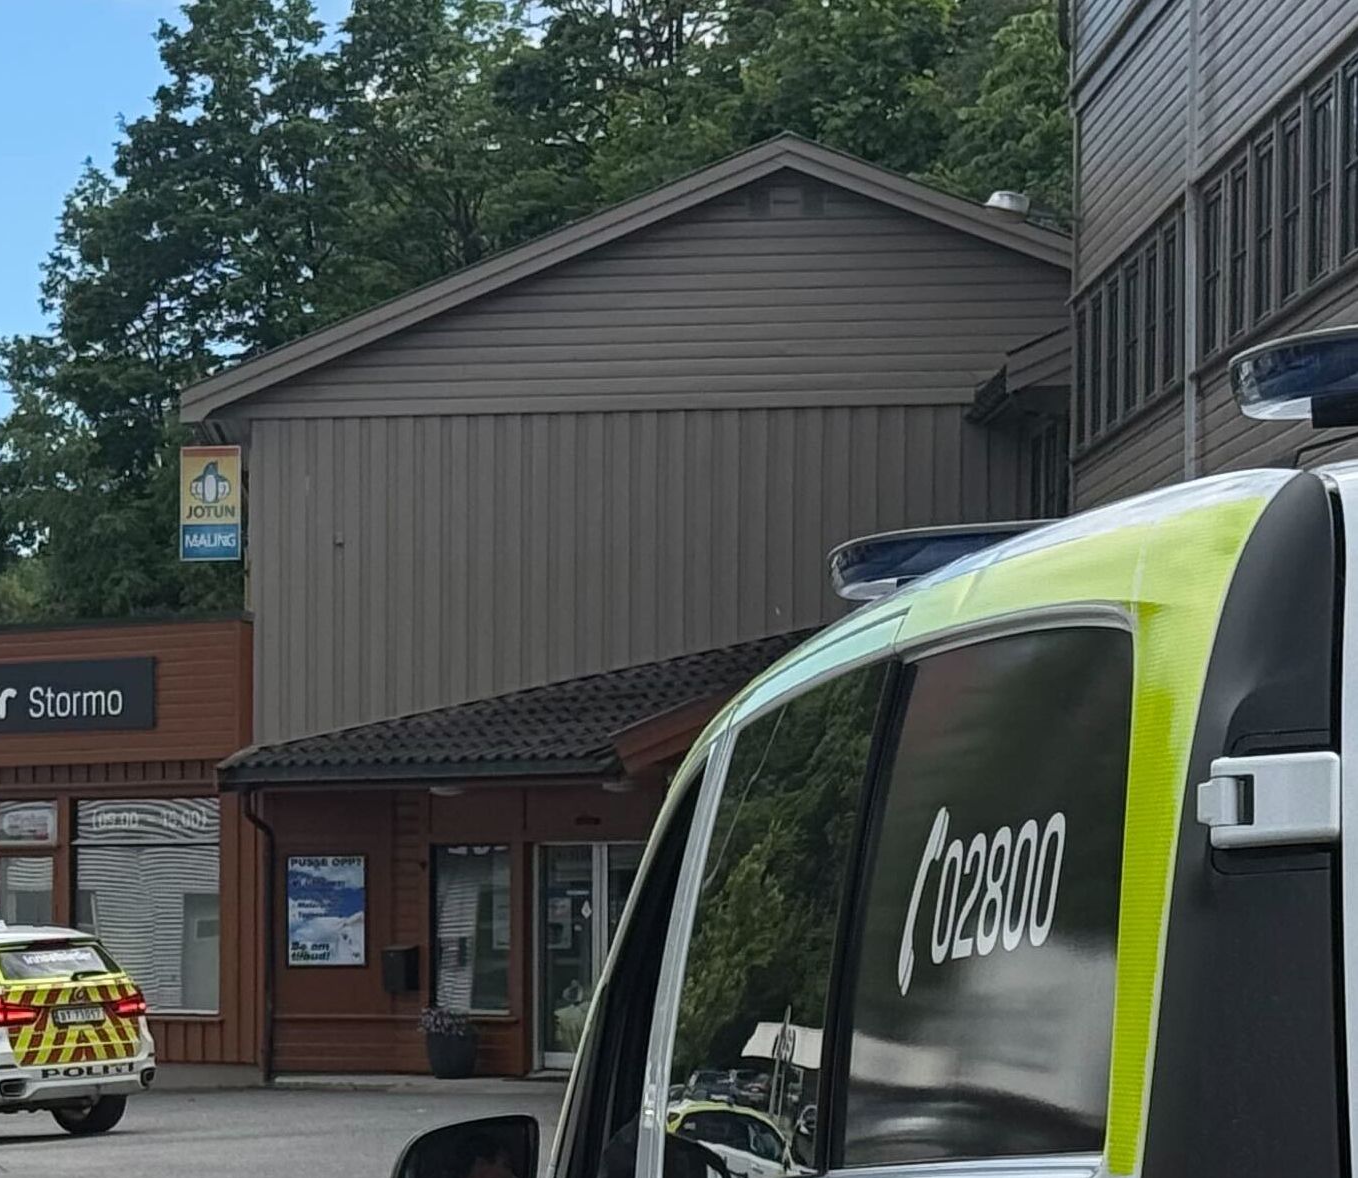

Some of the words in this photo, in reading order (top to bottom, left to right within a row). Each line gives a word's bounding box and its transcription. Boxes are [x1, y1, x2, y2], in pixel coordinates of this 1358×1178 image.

[186, 504, 236, 519] JOTUN
[185, 532, 236, 548] MALING
[28, 686, 124, 719] Stormo
[931, 812, 1066, 965] 02800
[41, 1062, 134, 1078] POLITI
